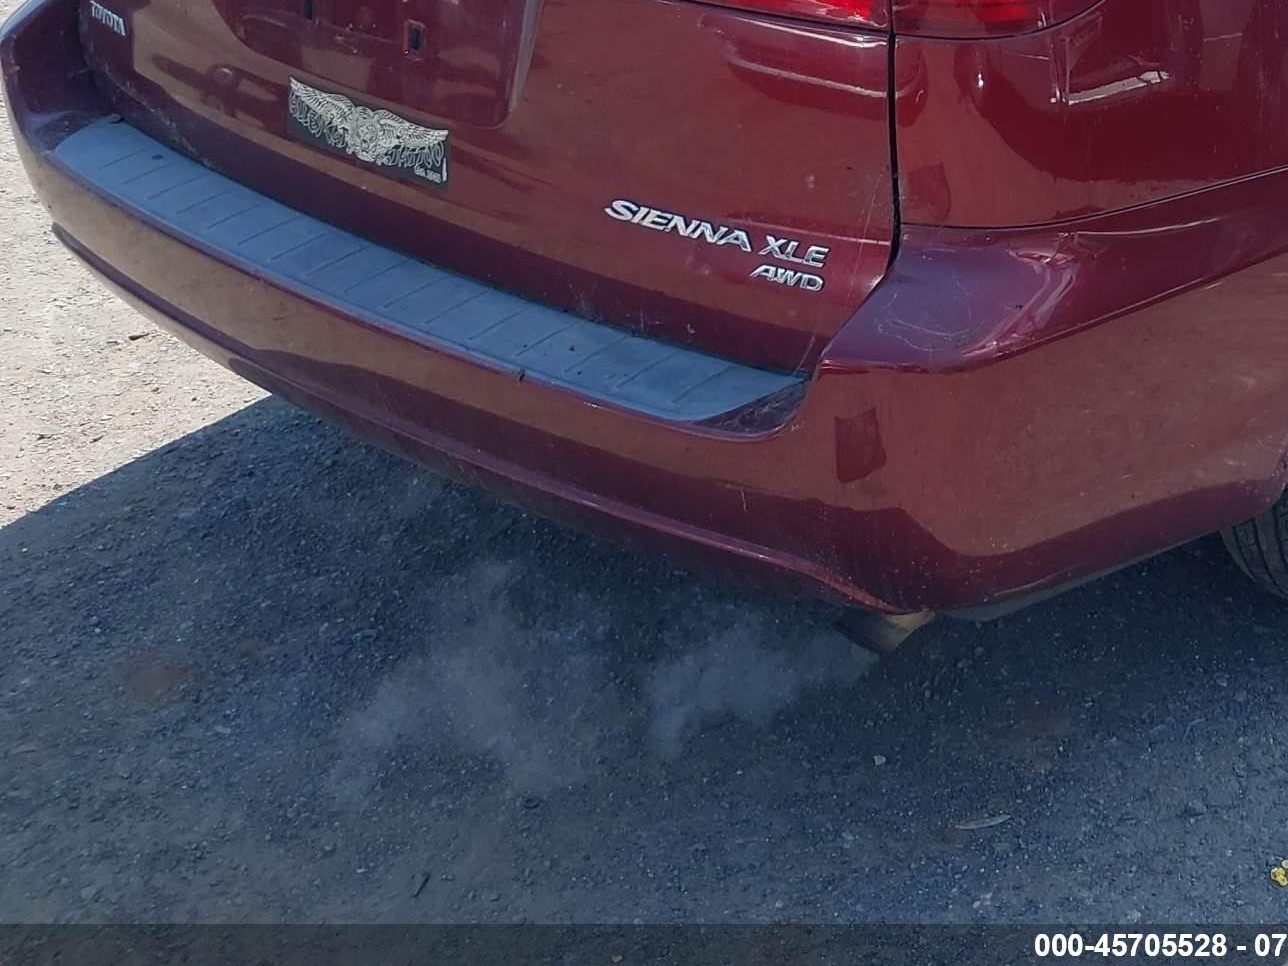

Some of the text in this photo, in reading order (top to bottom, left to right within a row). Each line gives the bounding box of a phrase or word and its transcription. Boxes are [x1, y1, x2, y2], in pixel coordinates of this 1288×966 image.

[89, 0, 126, 36] TOYOTA
[604, 199, 830, 267] SIENNA XLE
[750, 264, 824, 291] AWD
